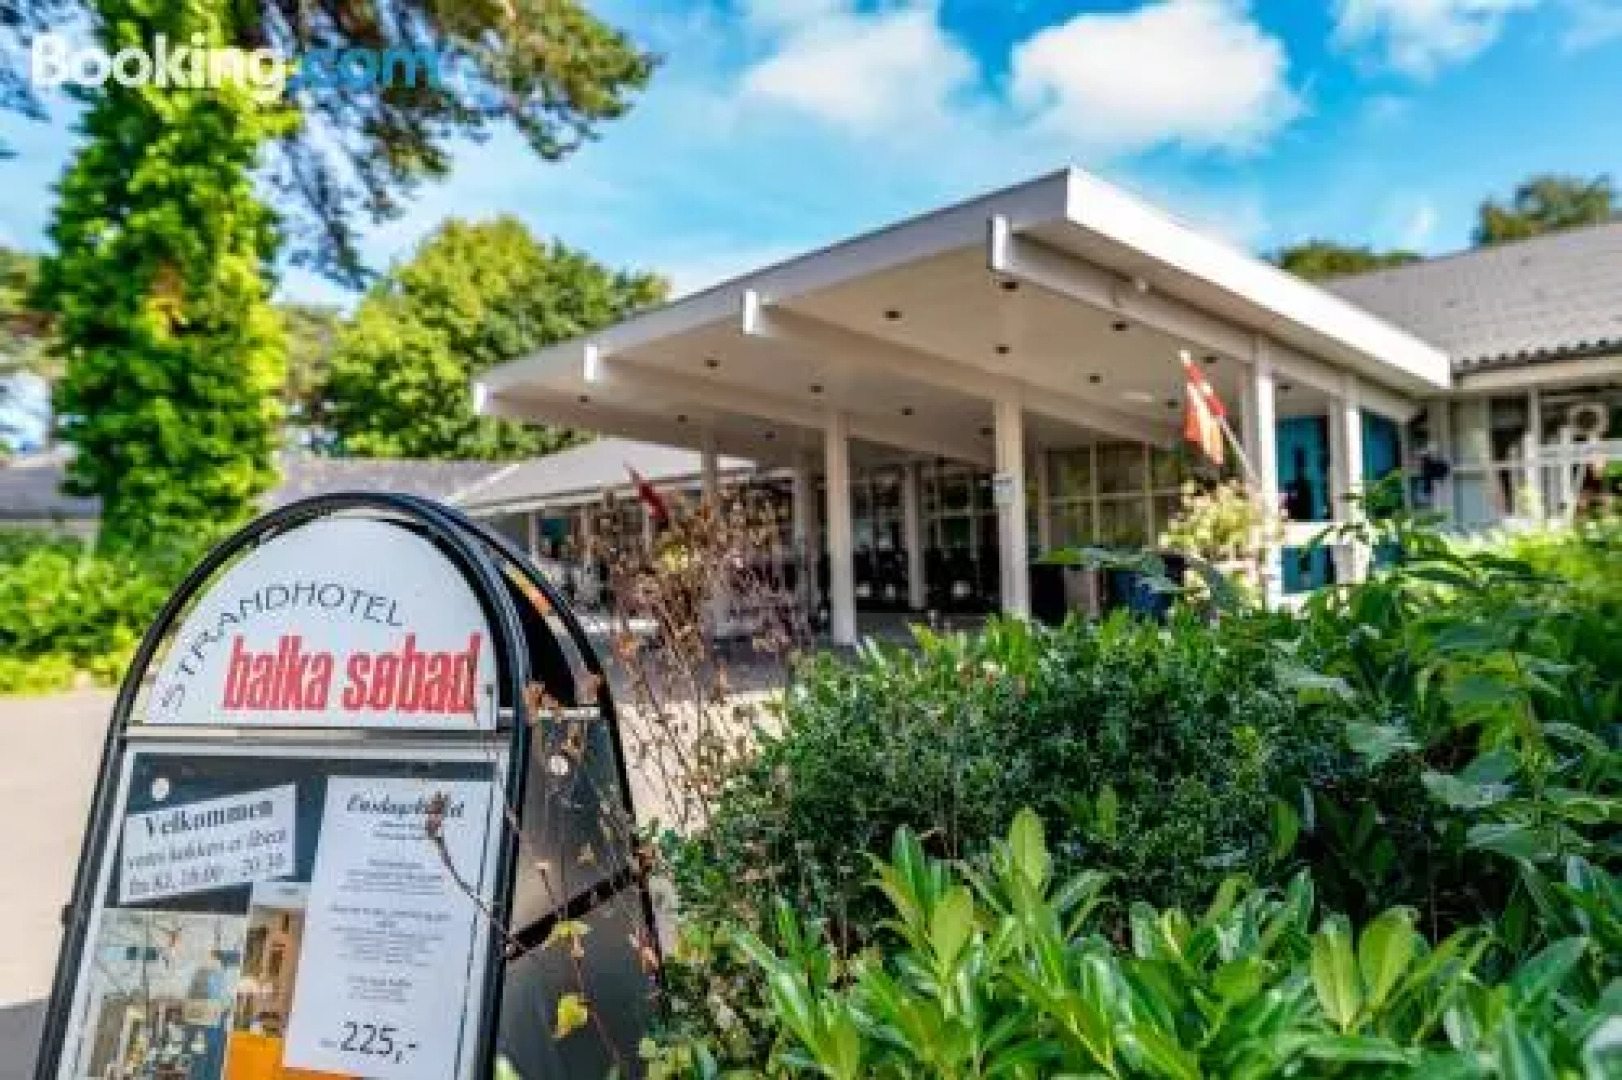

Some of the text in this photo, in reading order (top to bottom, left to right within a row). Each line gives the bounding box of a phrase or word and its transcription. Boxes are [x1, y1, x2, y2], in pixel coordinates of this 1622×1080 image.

[160, 580, 403, 709] STRANDHOTEL
[221, 630, 482, 716] balka søbad
[145, 799, 274, 837] Velkommen
[339, 1020, 418, 1065] 225,-
